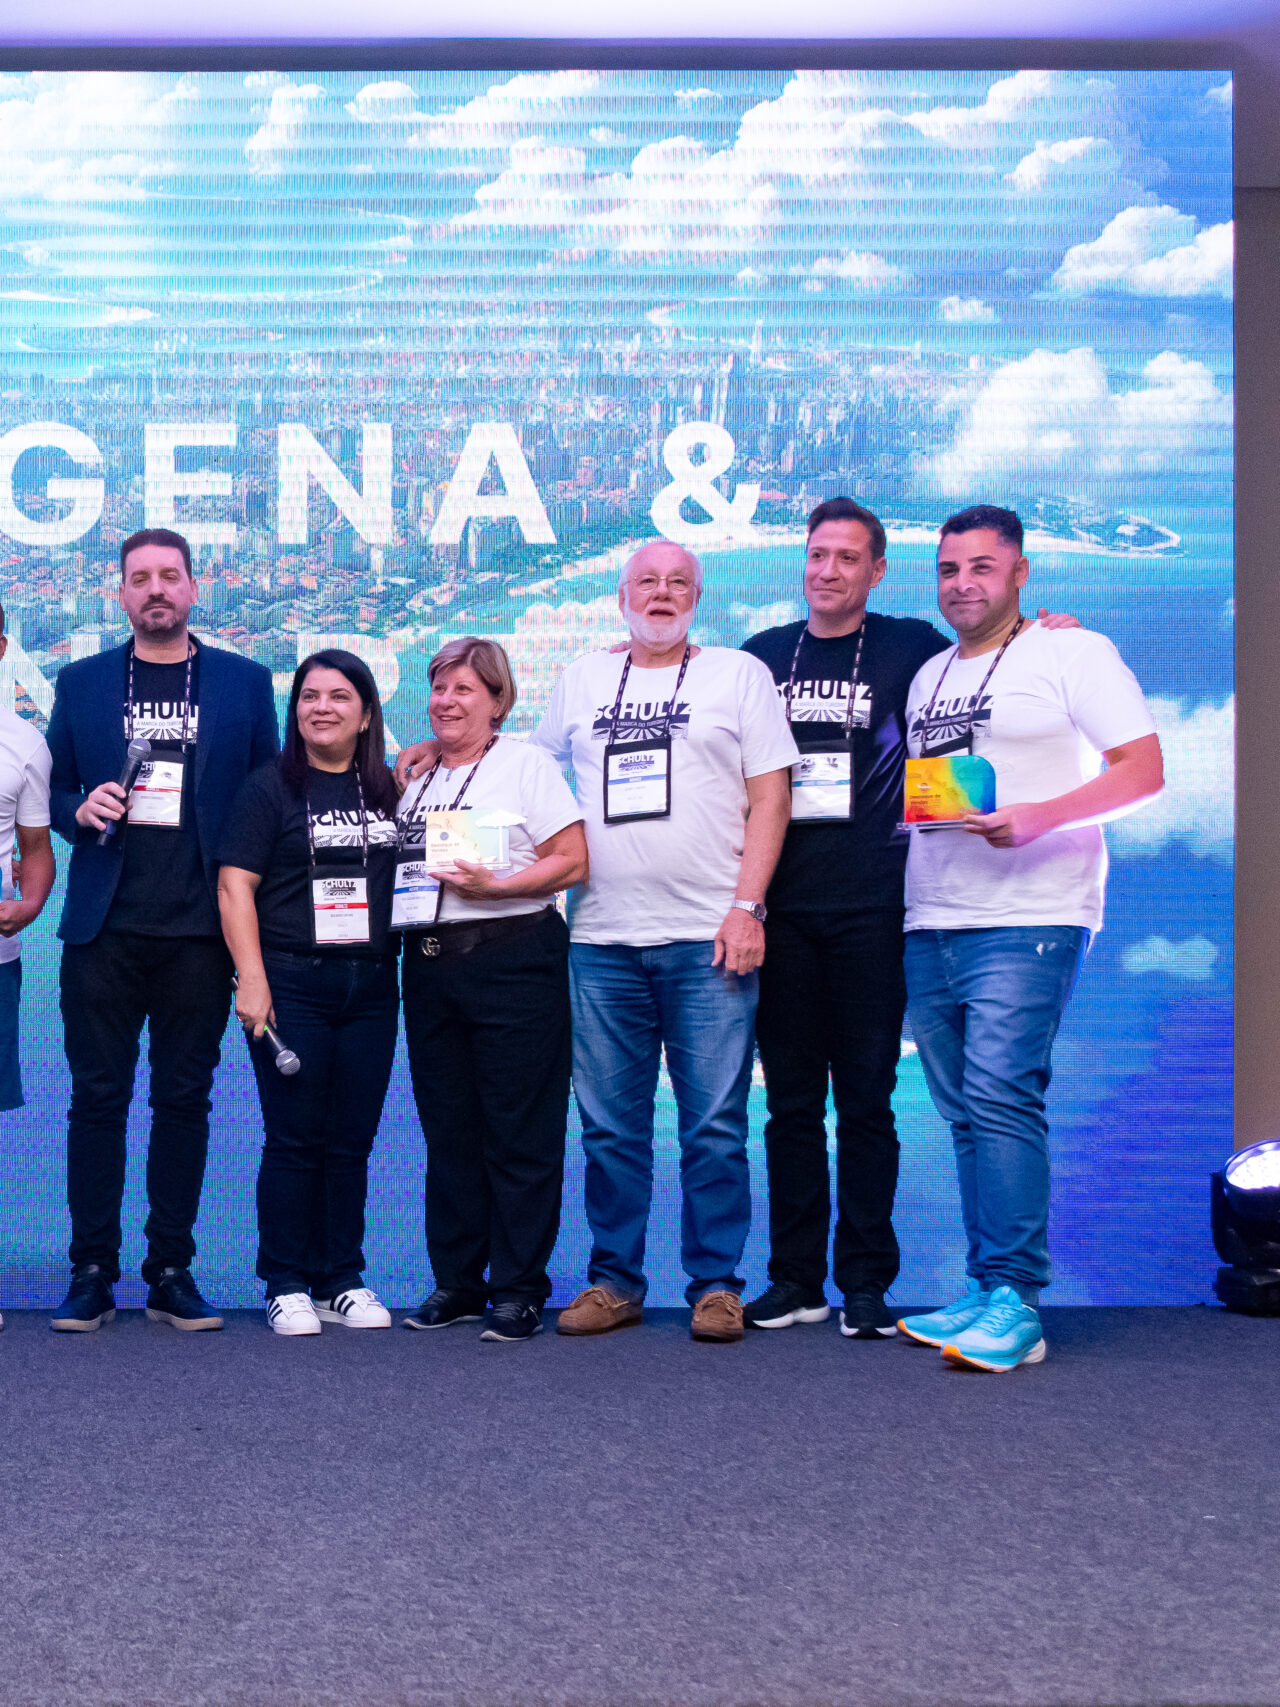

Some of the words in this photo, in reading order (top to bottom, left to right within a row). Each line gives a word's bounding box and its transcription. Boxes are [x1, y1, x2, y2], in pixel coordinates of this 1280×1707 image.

[650, 419, 761, 547] &
[124, 701, 196, 719] CHULT
[593, 701, 692, 721] SCHULTZ
[322, 880, 357, 888] SCHULTZ
